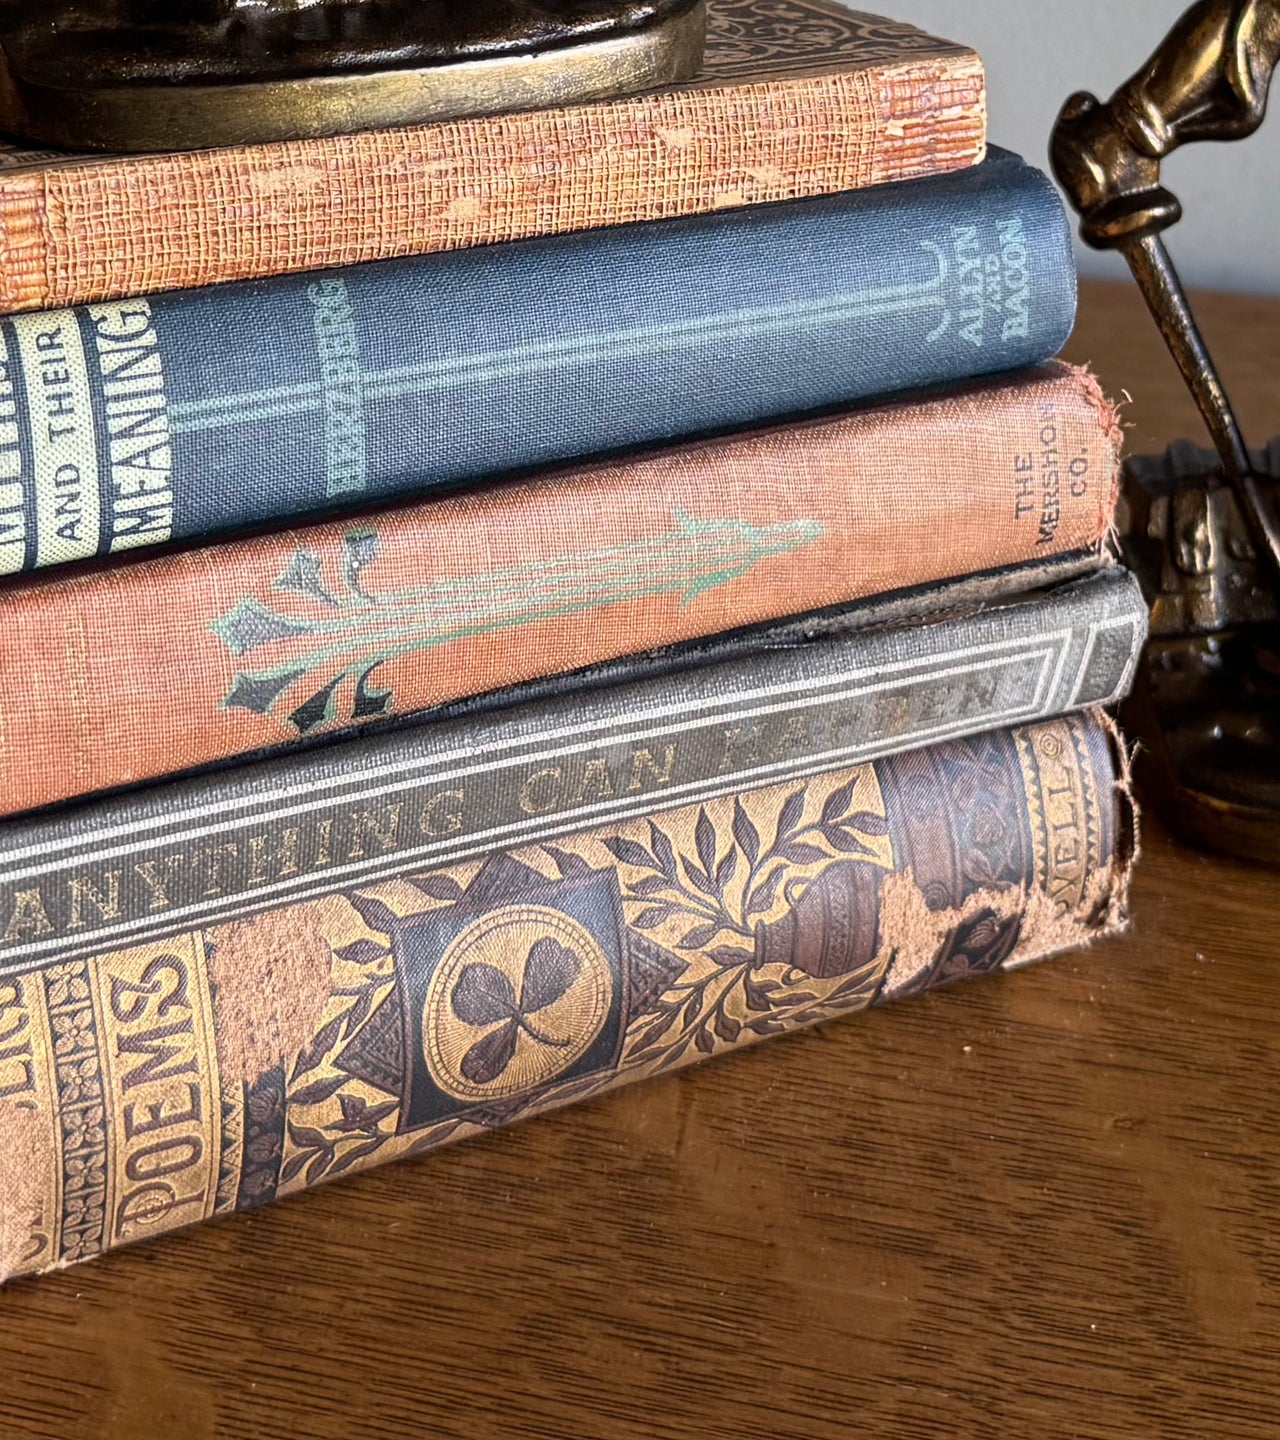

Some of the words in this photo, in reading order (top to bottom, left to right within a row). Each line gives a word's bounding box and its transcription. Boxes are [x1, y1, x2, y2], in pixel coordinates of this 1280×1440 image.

[951, 224, 983, 347] ALLYN
[998, 219, 1028, 341] BACON
[37, 327, 78, 443] THEIR
[94, 297, 173, 543] MEANING
[52, 463, 82, 542] AND
[1014, 452, 1034, 520] THE
[1036, 401, 1060, 546] MERSHON
[1067, 447, 1088, 498] CO.
[520, 744, 676, 814] CAN
[107, 953, 206, 1238] POEMS
